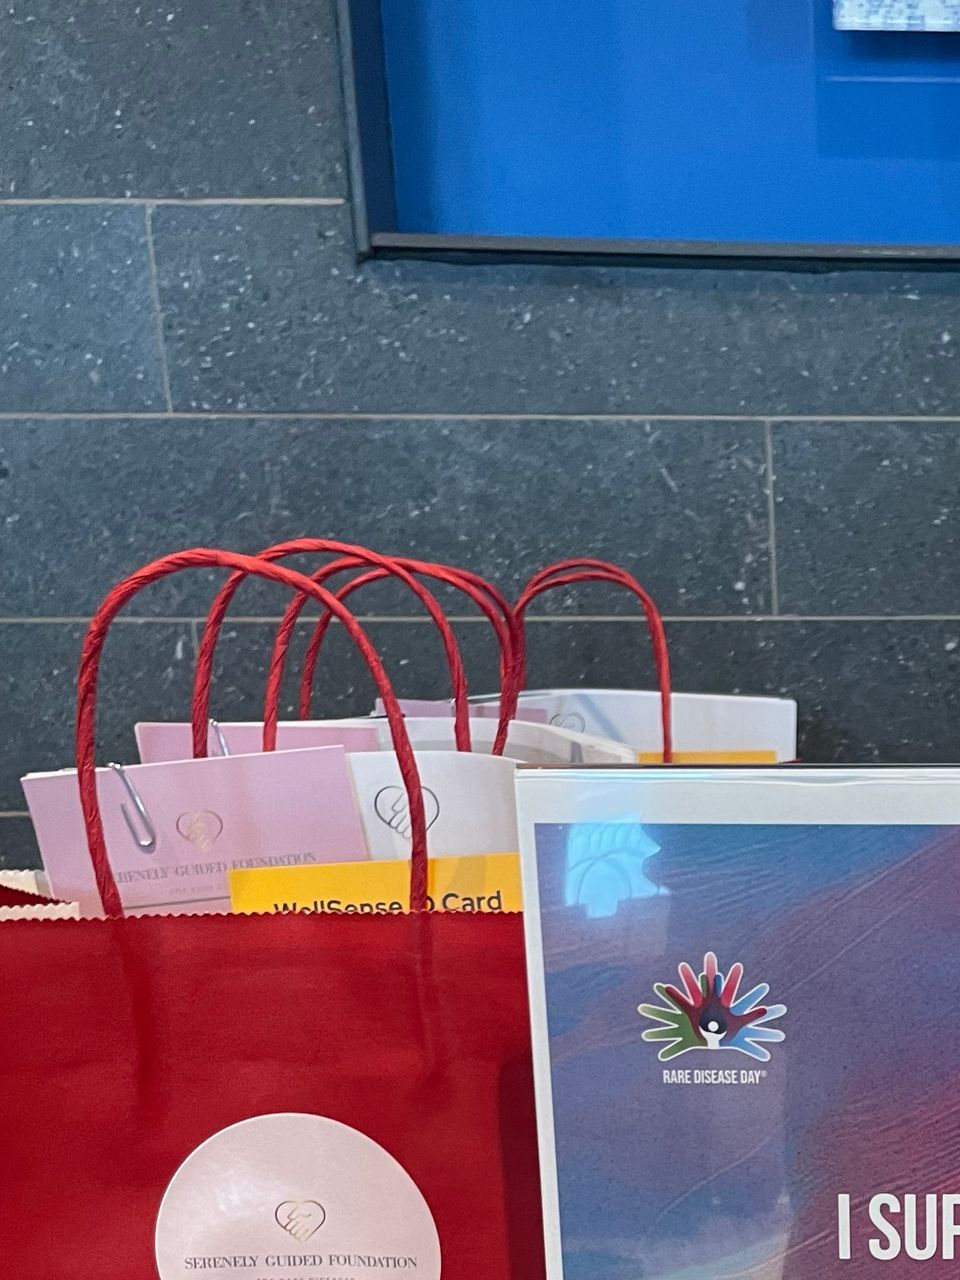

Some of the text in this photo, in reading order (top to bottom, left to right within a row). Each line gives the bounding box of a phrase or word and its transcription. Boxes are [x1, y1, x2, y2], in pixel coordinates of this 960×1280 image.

[442, 889, 502, 913] Card
[662, 1069, 691, 1084] RARE
[693, 1069, 738, 1085] DISEASE
[838, 1193, 851, 1260] I
[184, 1254, 418, 1270] SERENELY GUIDED FOUNDATION
